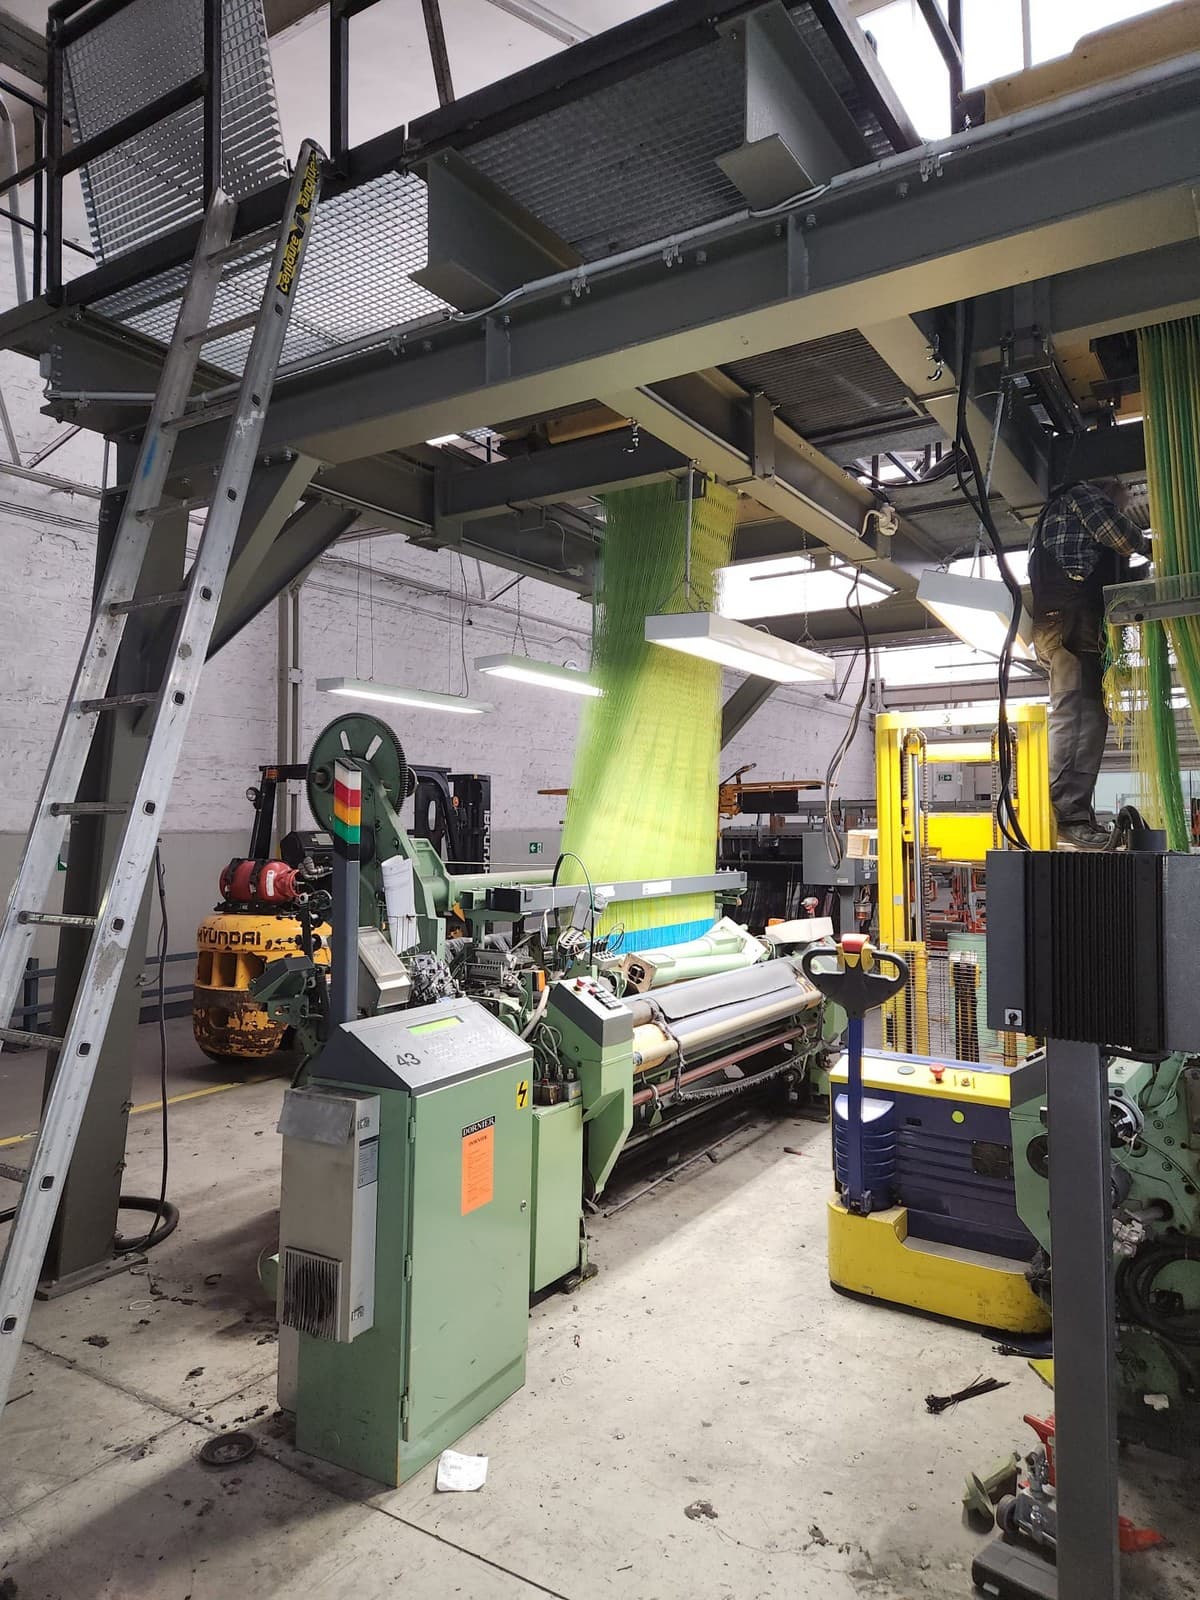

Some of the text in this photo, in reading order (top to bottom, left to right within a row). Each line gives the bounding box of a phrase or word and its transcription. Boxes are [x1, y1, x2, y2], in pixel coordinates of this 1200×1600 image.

[279, 235, 300, 293] centaure
[197, 927, 262, 946] HYUNDAI
[395, 1052, 421, 1068] 43
[462, 1116, 495, 1137] DORNIER
